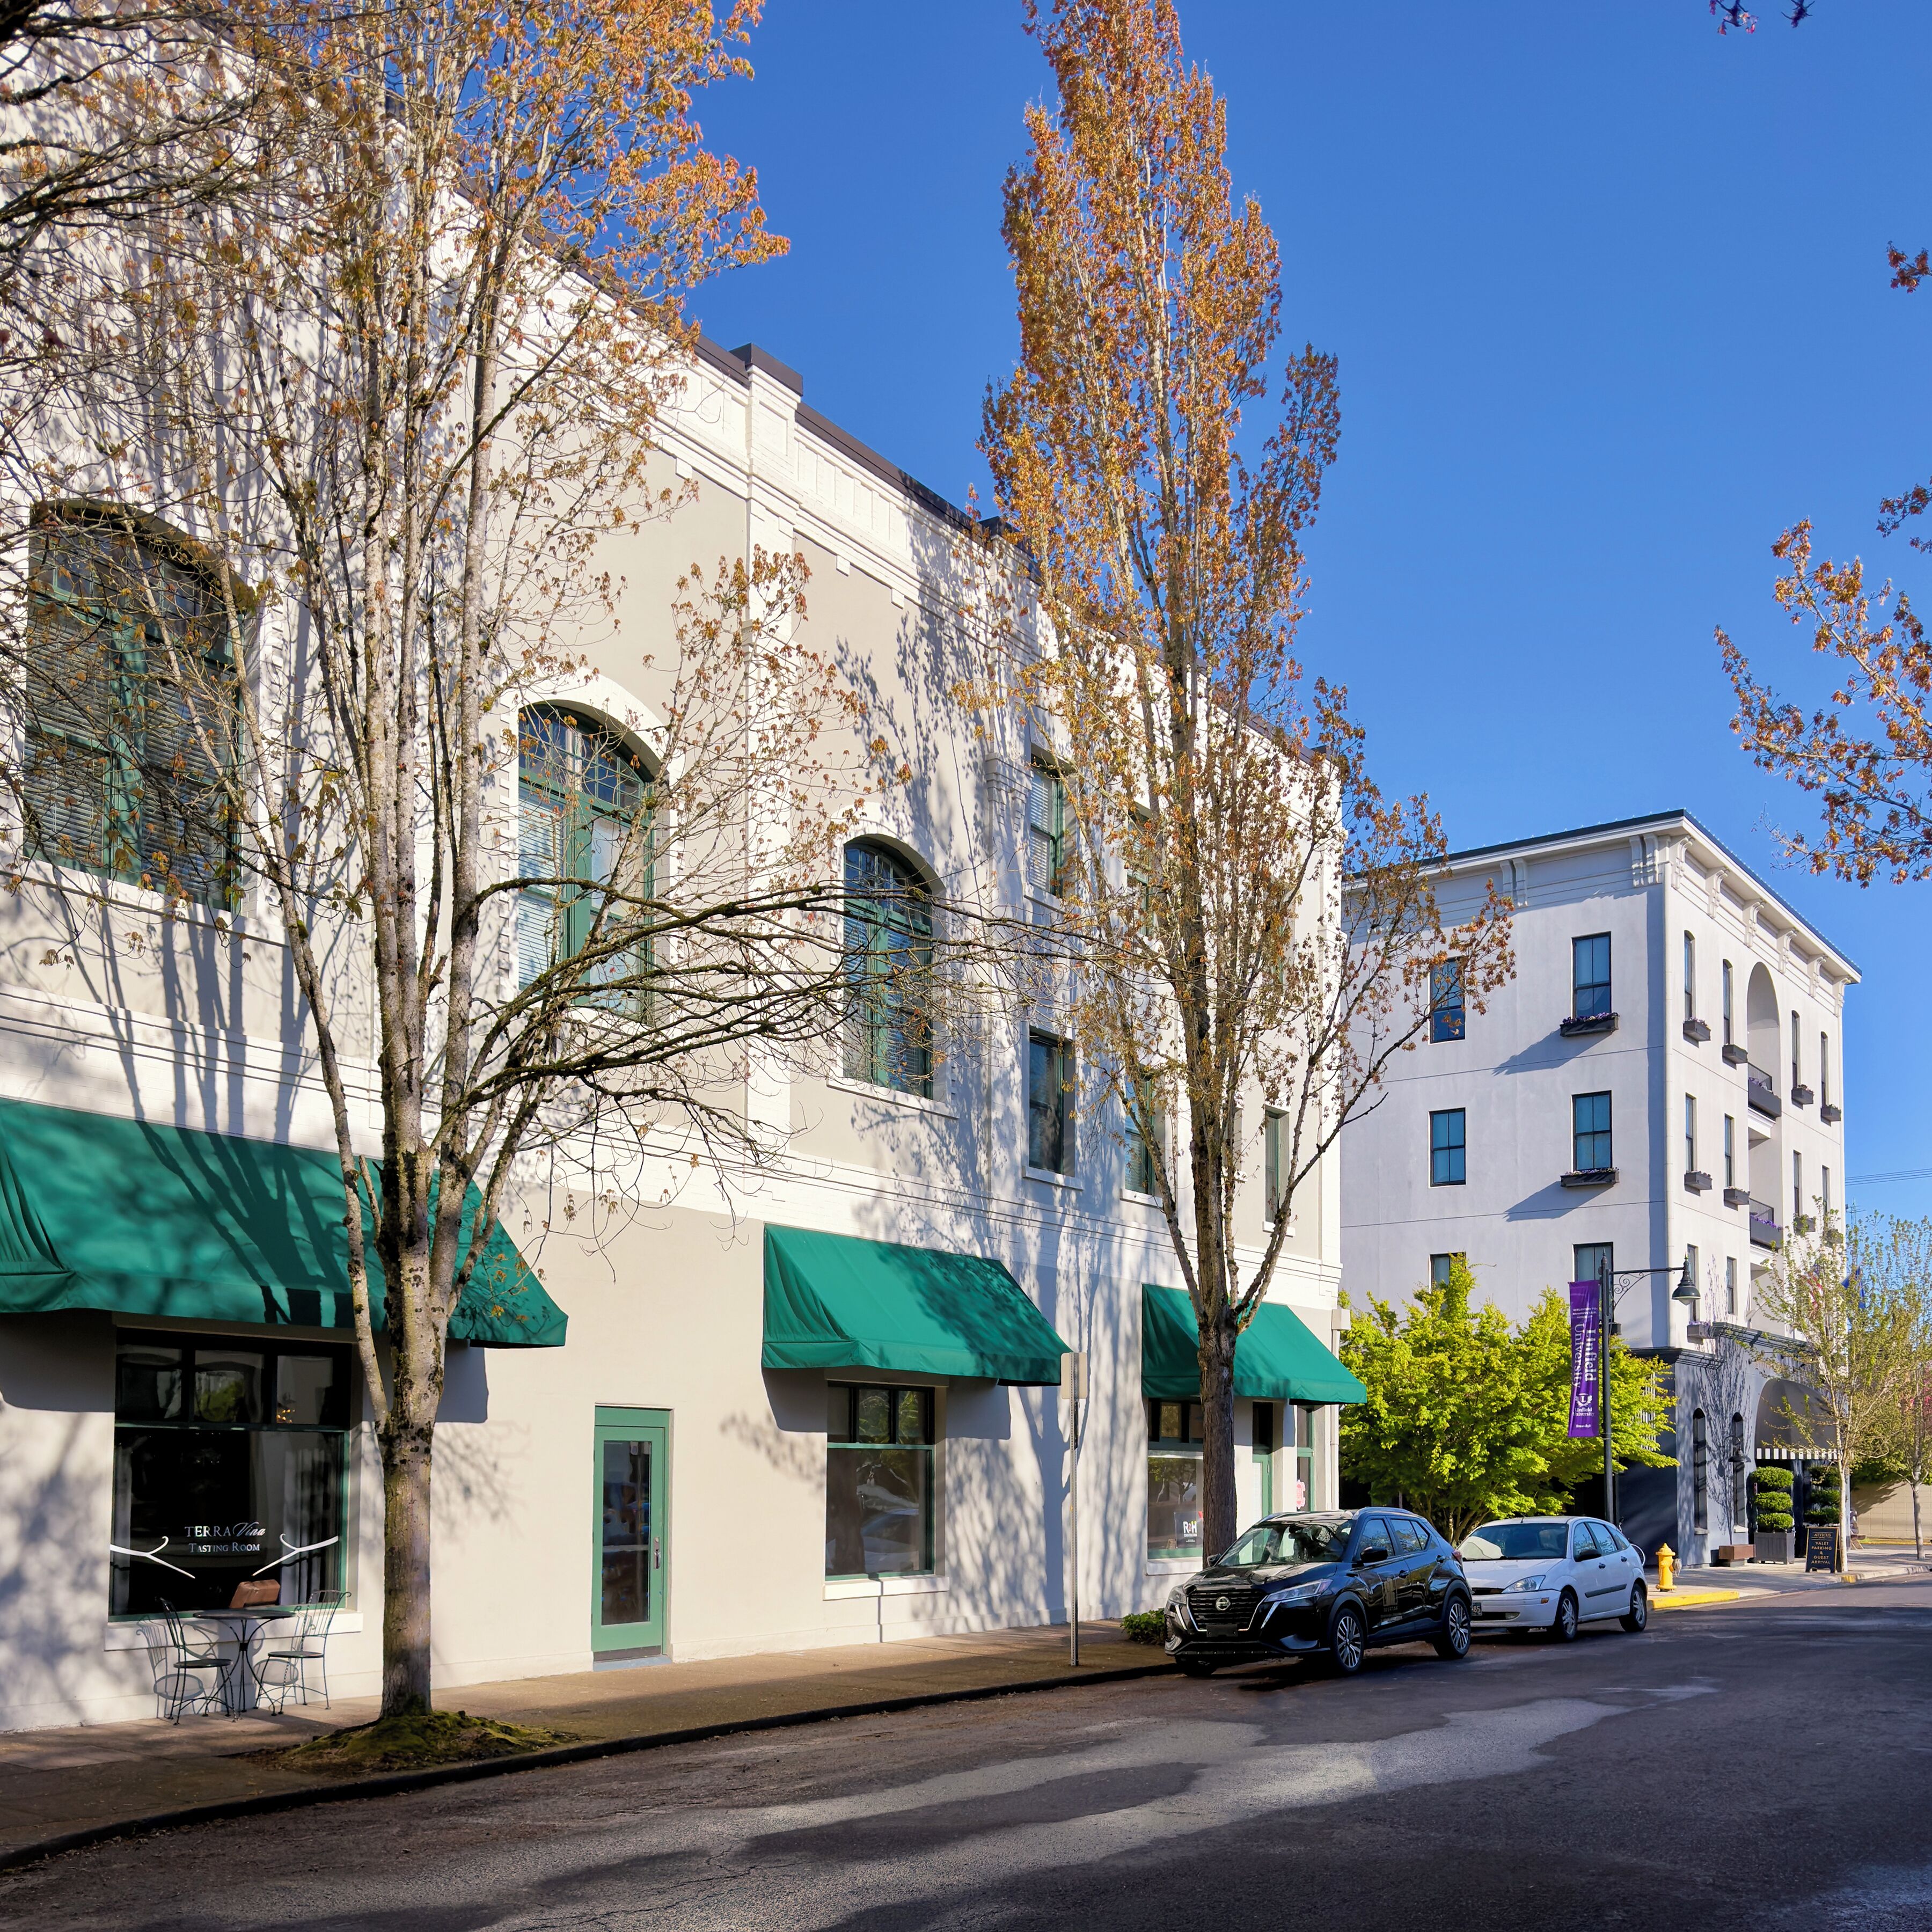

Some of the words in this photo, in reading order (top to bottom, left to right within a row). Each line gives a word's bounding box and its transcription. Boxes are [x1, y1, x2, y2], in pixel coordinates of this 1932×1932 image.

[1572, 1323, 1584, 1388] University
[1585, 1329, 1597, 1381] Linfield
[184, 1526, 231, 1537] TERRA
[232, 1521, 266, 1537] Vina
[1183, 1521, 1197, 1533] R&H
[188, 1543, 229, 1553] TASTING
[232, 1542, 260, 1552] ROOM
